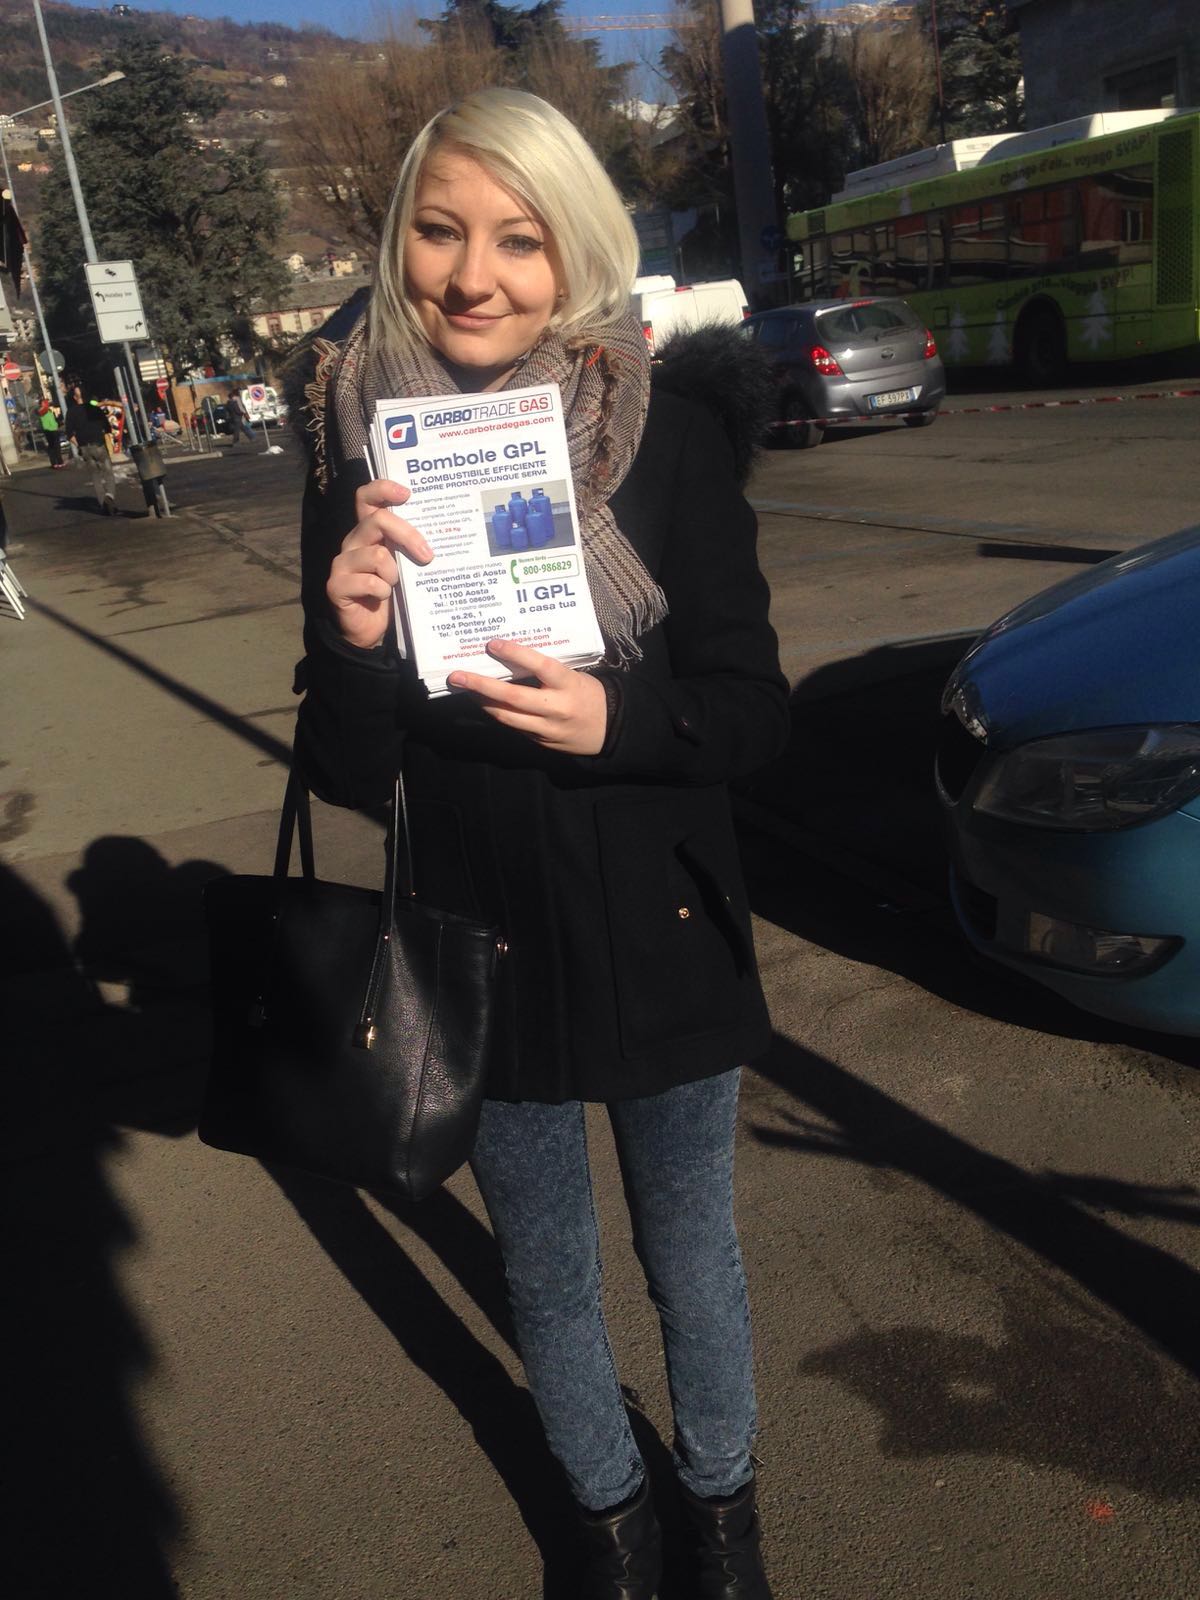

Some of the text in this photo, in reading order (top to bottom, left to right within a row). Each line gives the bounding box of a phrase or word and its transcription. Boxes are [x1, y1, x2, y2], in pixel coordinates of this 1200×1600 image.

[423, 397, 549, 428] CARBOTRADE GAS
[438, 415, 554, 439] www.carbotradegas.com
[406, 440, 547, 474] Bombole GPL
[410, 460, 547, 486] IL COMBUSTIBILE EFFICIENTE
[412, 483, 444, 494] SEMPRE
[521, 469, 547, 479] SERVA
[523, 560, 572, 575] 800-986829
[415, 568, 507, 587] punto vendita di Aosta
[426, 585, 439, 593] Via
[487, 577, 498, 585] 32
[439, 588, 489, 600] 11100 Aosta
[534, 583, 575, 600] GPL
[519, 600, 576, 614] a casa tua
[432, 616, 506, 631] 11024 Pontey (AO)
